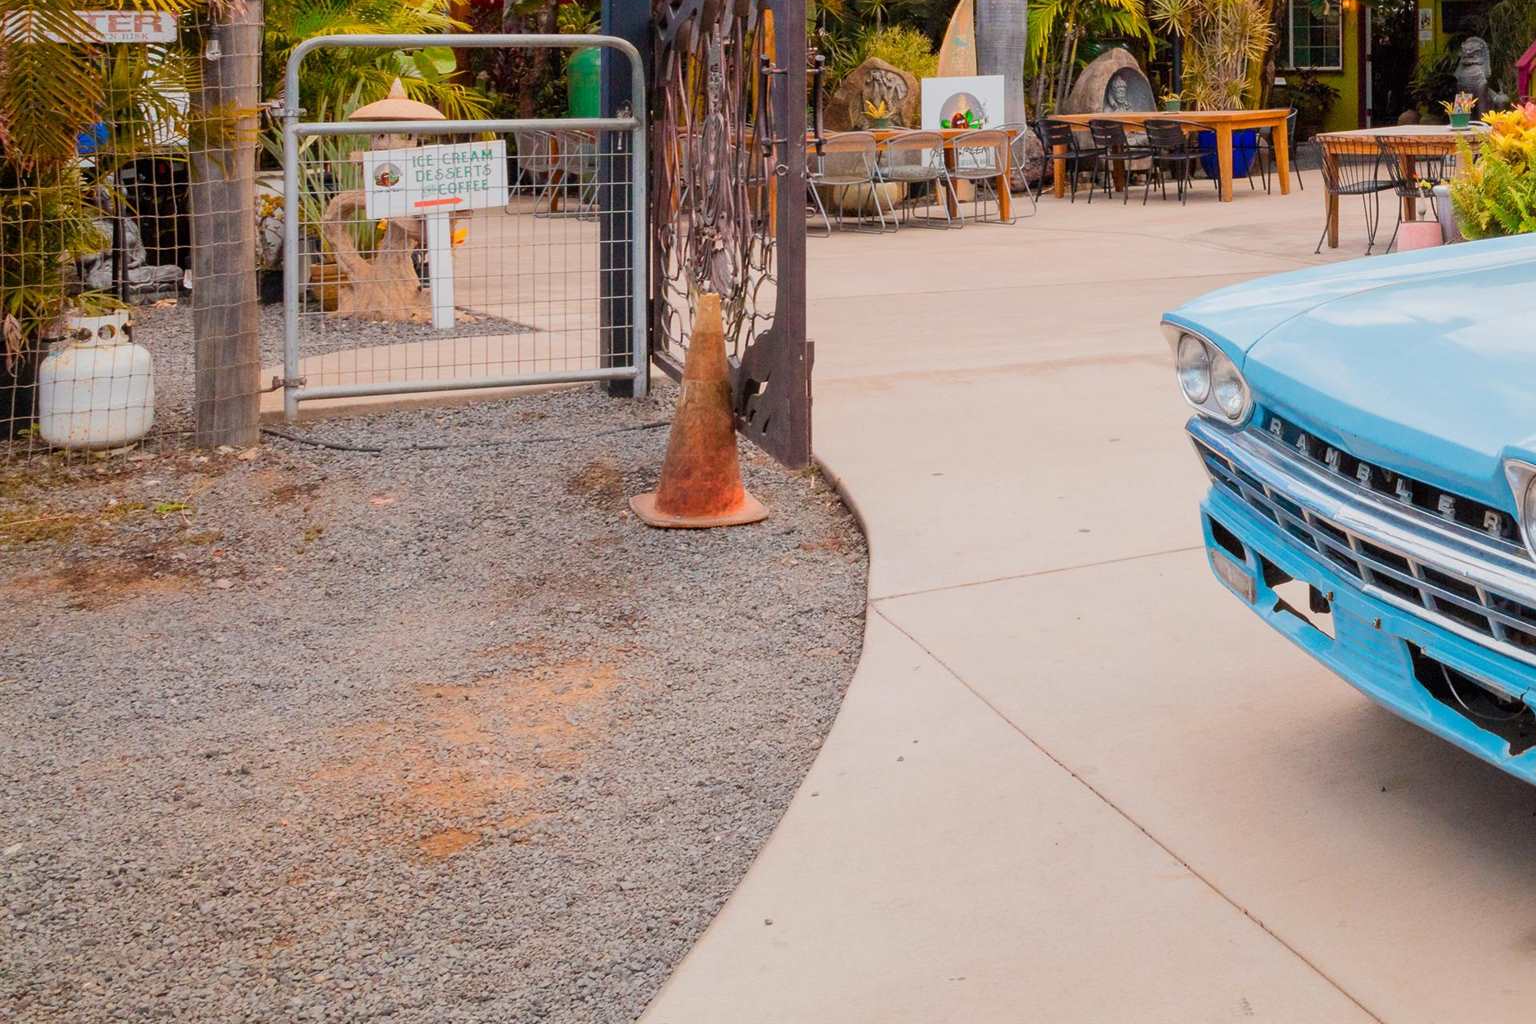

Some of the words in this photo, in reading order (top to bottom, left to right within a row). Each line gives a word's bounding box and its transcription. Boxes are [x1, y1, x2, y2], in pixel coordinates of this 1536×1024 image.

[412, 154, 433, 168] ICE
[442, 149, 494, 165] CREAM
[415, 163, 492, 183] DESSERTS
[438, 179, 489, 196] COFFEE
[1270, 417, 1499, 532] RAMBLER
